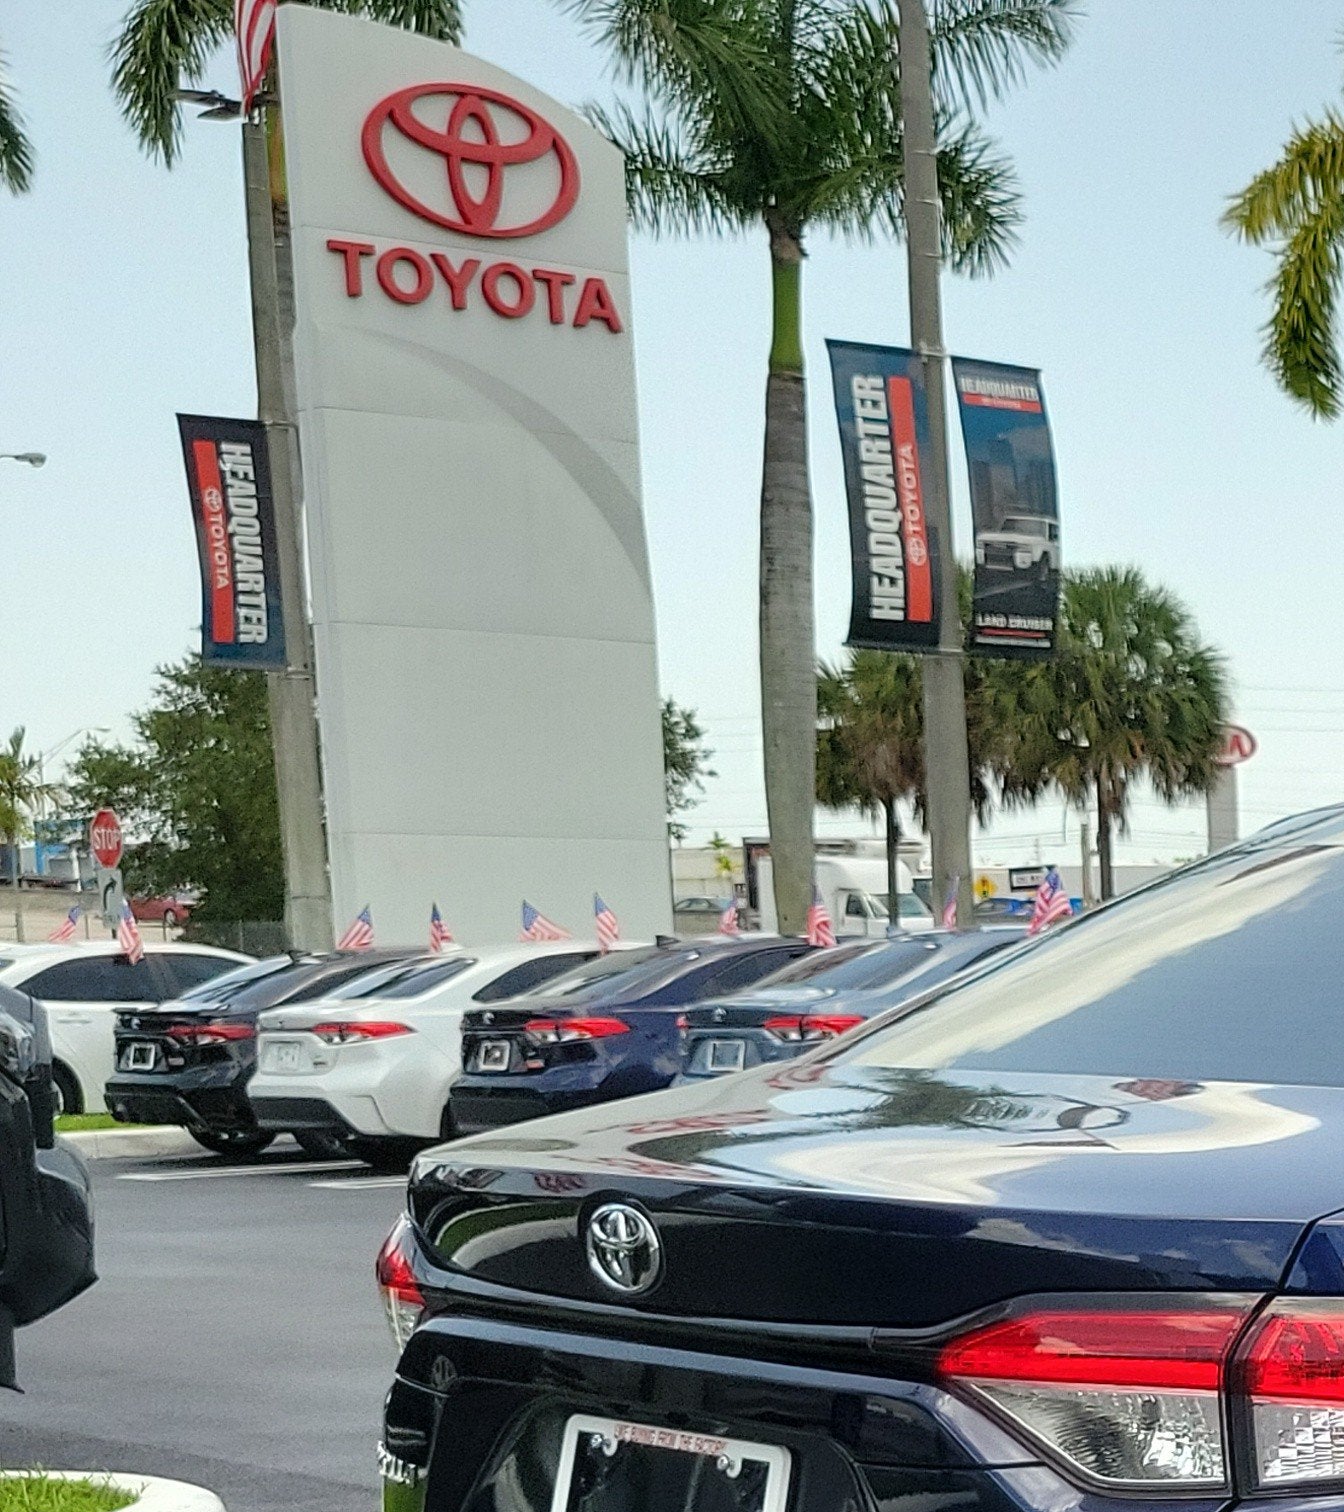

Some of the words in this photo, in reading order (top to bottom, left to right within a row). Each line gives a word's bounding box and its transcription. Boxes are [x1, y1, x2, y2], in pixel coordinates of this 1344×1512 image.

[326, 239, 623, 334] TOYOTA
[852, 374, 906, 622] HEADQUARTER
[899, 444, 925, 538] TOYOTA
[207, 513, 230, 589] TOYOTA
[219, 441, 269, 644] HEADQUARTER
[93, 828, 121, 851] STOP
